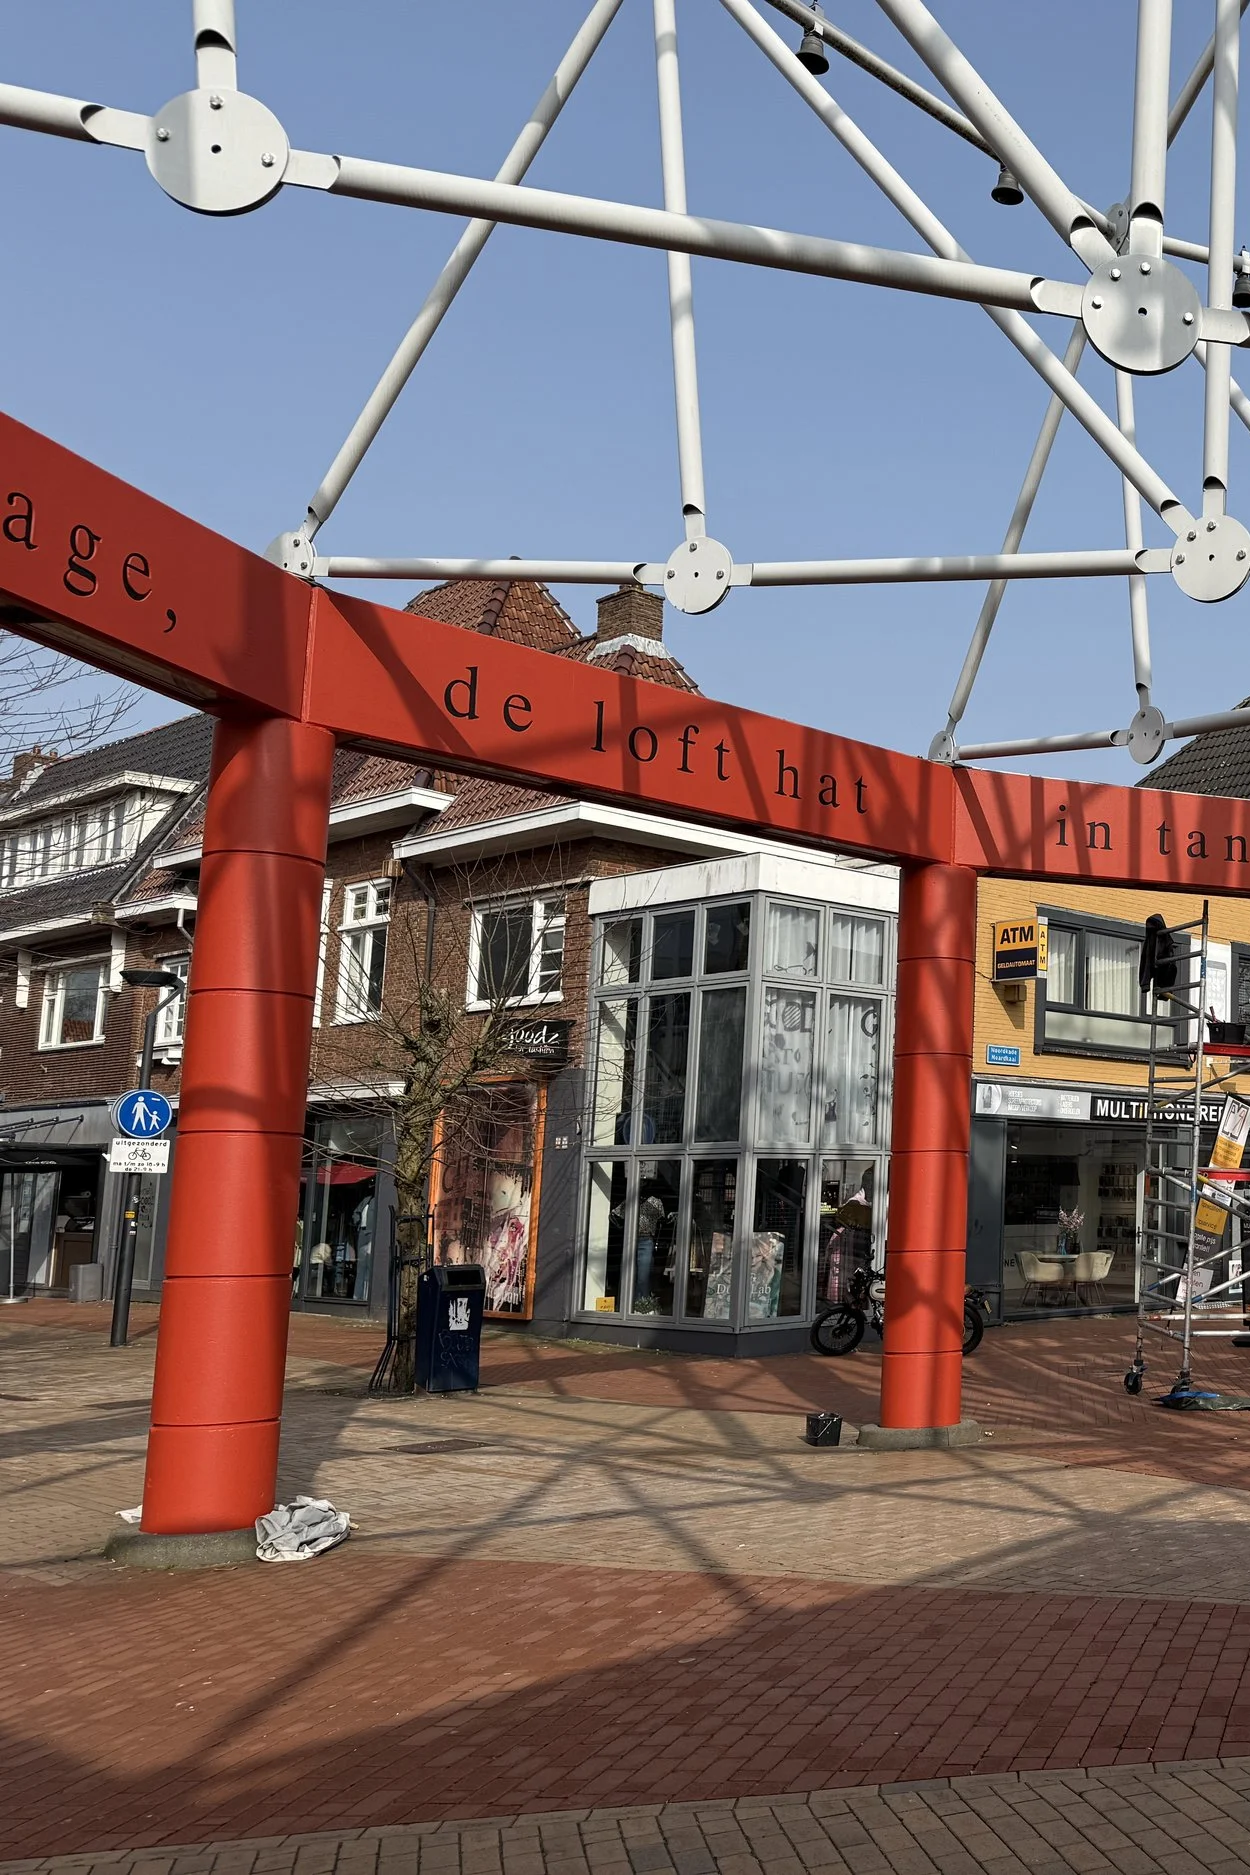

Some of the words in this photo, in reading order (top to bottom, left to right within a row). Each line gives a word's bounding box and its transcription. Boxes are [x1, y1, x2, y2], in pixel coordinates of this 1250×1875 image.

[443, 665, 534, 733] de
[590, 700, 731, 782] loft
[774, 748, 869, 815] hat
[1055, 804, 1113, 851] in
[1000, 925, 1034, 944] ATM
[997, 959, 1035, 969] GELDAUTOMAAT
